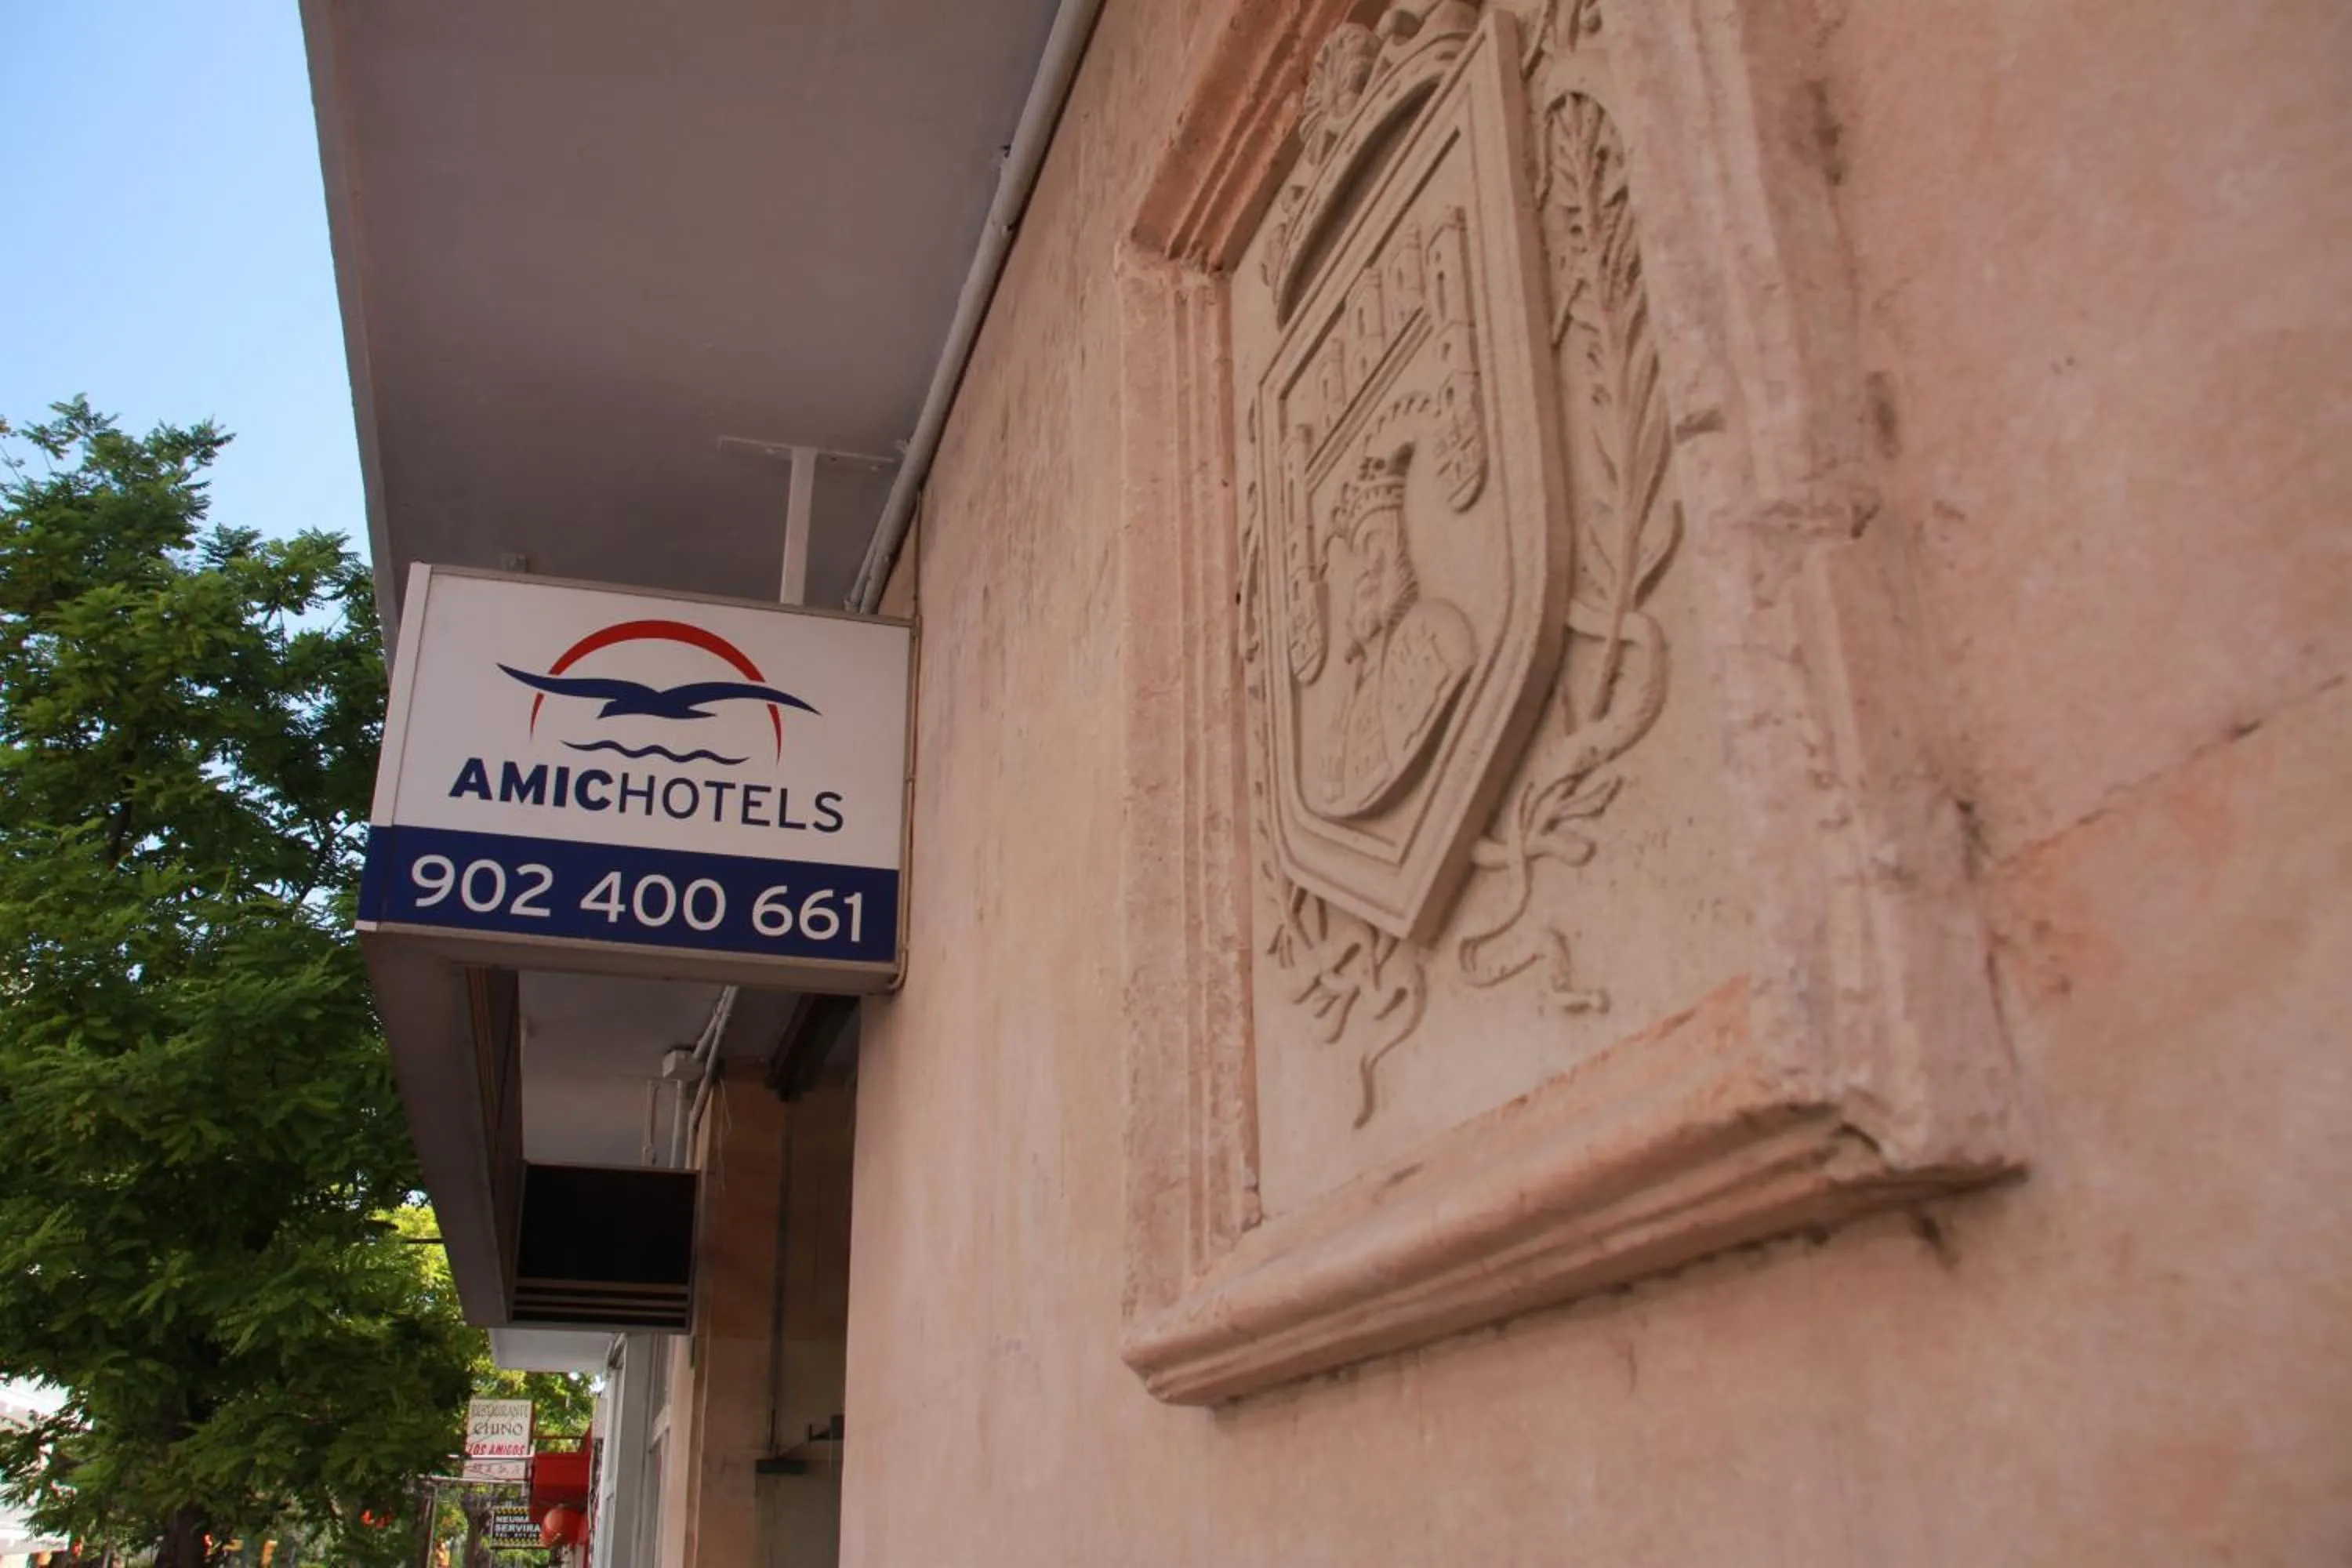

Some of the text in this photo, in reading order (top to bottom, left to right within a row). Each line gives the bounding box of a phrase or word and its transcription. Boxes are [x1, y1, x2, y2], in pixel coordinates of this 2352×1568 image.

[448, 757, 845, 833] AMICHOTELS
[410, 854, 863, 943] 902 400 661
[473, 1421, 523, 1436] CHINO
